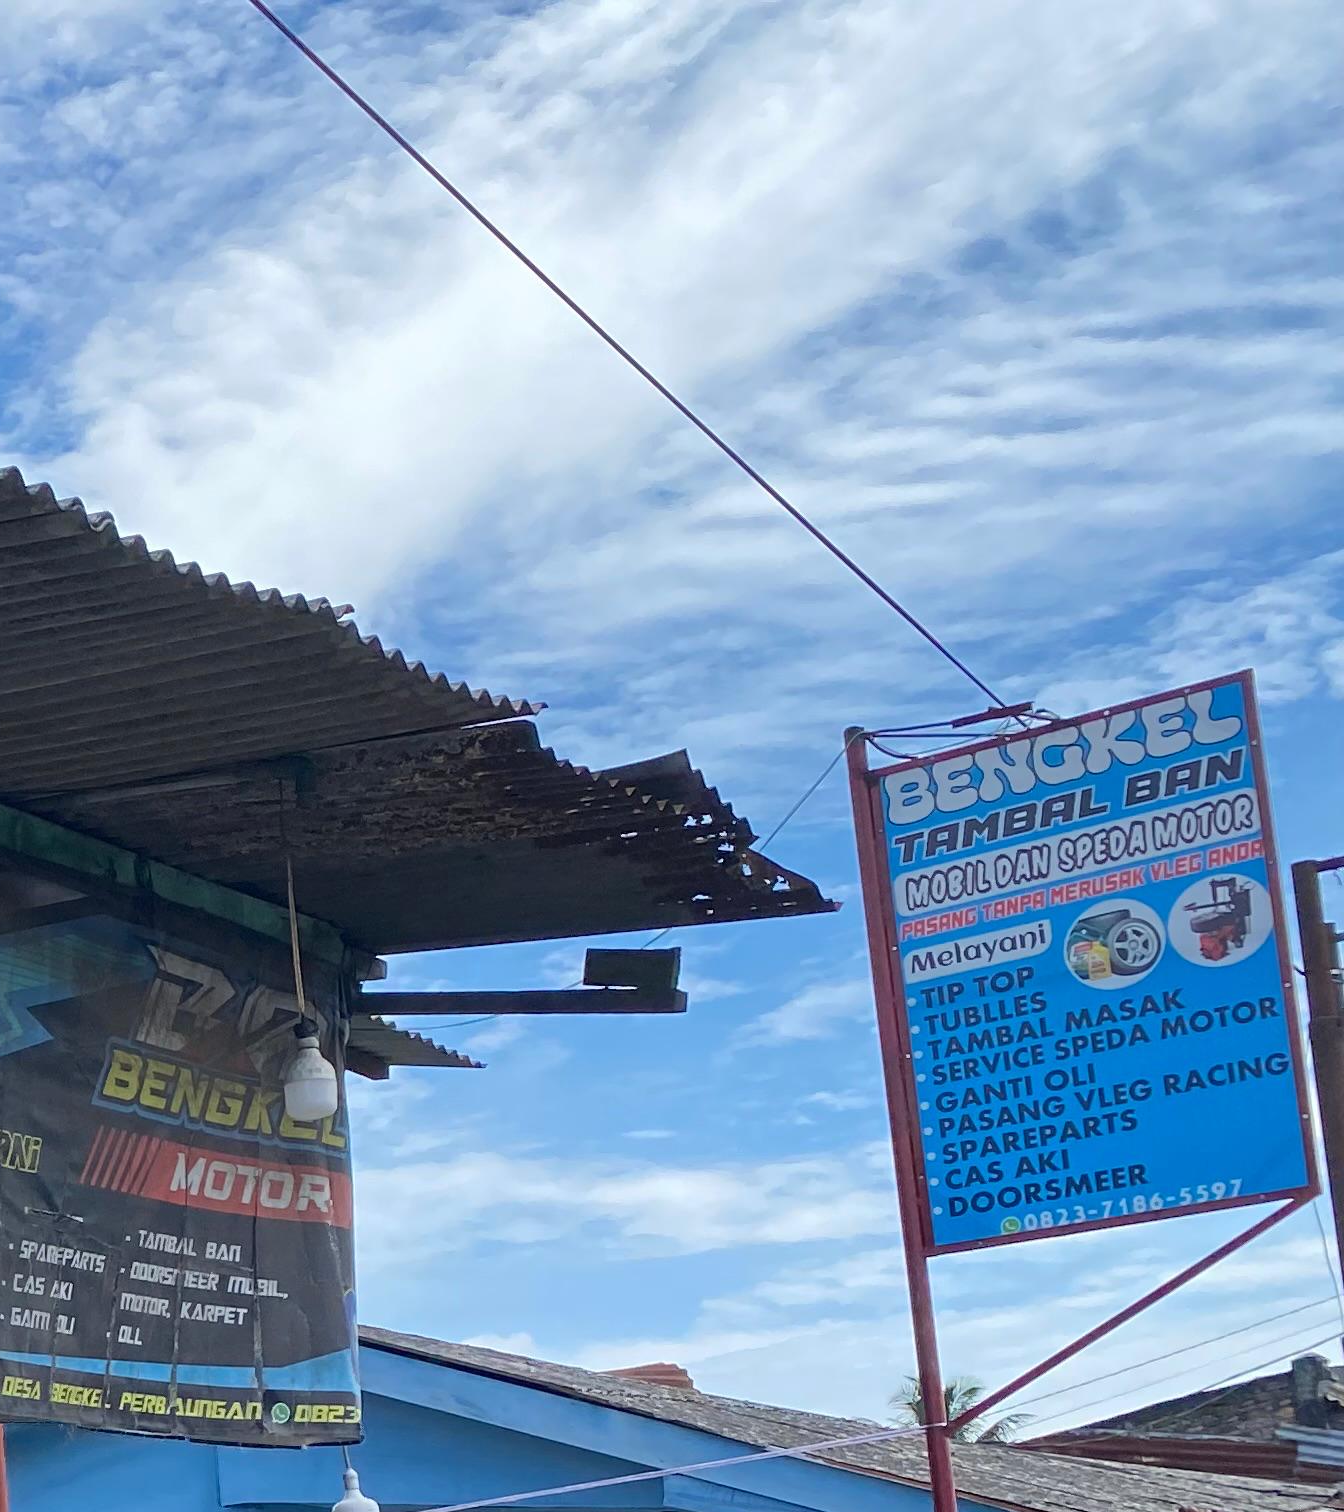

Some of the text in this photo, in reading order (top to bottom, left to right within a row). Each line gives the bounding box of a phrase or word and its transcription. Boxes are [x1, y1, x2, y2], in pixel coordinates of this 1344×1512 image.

[886, 690, 1244, 825] BENGKEL
[893, 749, 1246, 864] TAMBAL BAN
[905, 794, 1254, 911] MOBIL DAN SPEDA MOTOR
[899, 839, 1264, 941] PASANG TANPA MERUSAK VLEG ANDA
[911, 924, 1048, 974] Melayani
[920, 967, 1035, 1010] TIP TOP
[923, 993, 1048, 1035] TUBLLES
[927, 989, 1185, 1061] TAMBAL MASAK
[931, 997, 1278, 1085] SERVICE SPEDA MOTOR
[935, 1064, 1097, 1113] GANTI OLI
[938, 1053, 1290, 1138] PASANG VLEG RACING
[943, 1110, 1139, 1165] SPAREPARTS
[170, 1153, 333, 1212] MOTOR
[945, 1149, 1071, 1190] CAS AKI
[948, 1164, 1148, 1218] DOORSMEER
[1023, 1179, 1244, 1230] 0823-7186-5597
[138, 1230, 241, 1263] TAMBAL BAN
[13, 1274, 74, 1301] CAS AKI
[180, 1301, 248, 1325] KARPET
[2, 1376, 41, 1400] DESA
[119, 1392, 261, 1420] PERBAUNGAN
